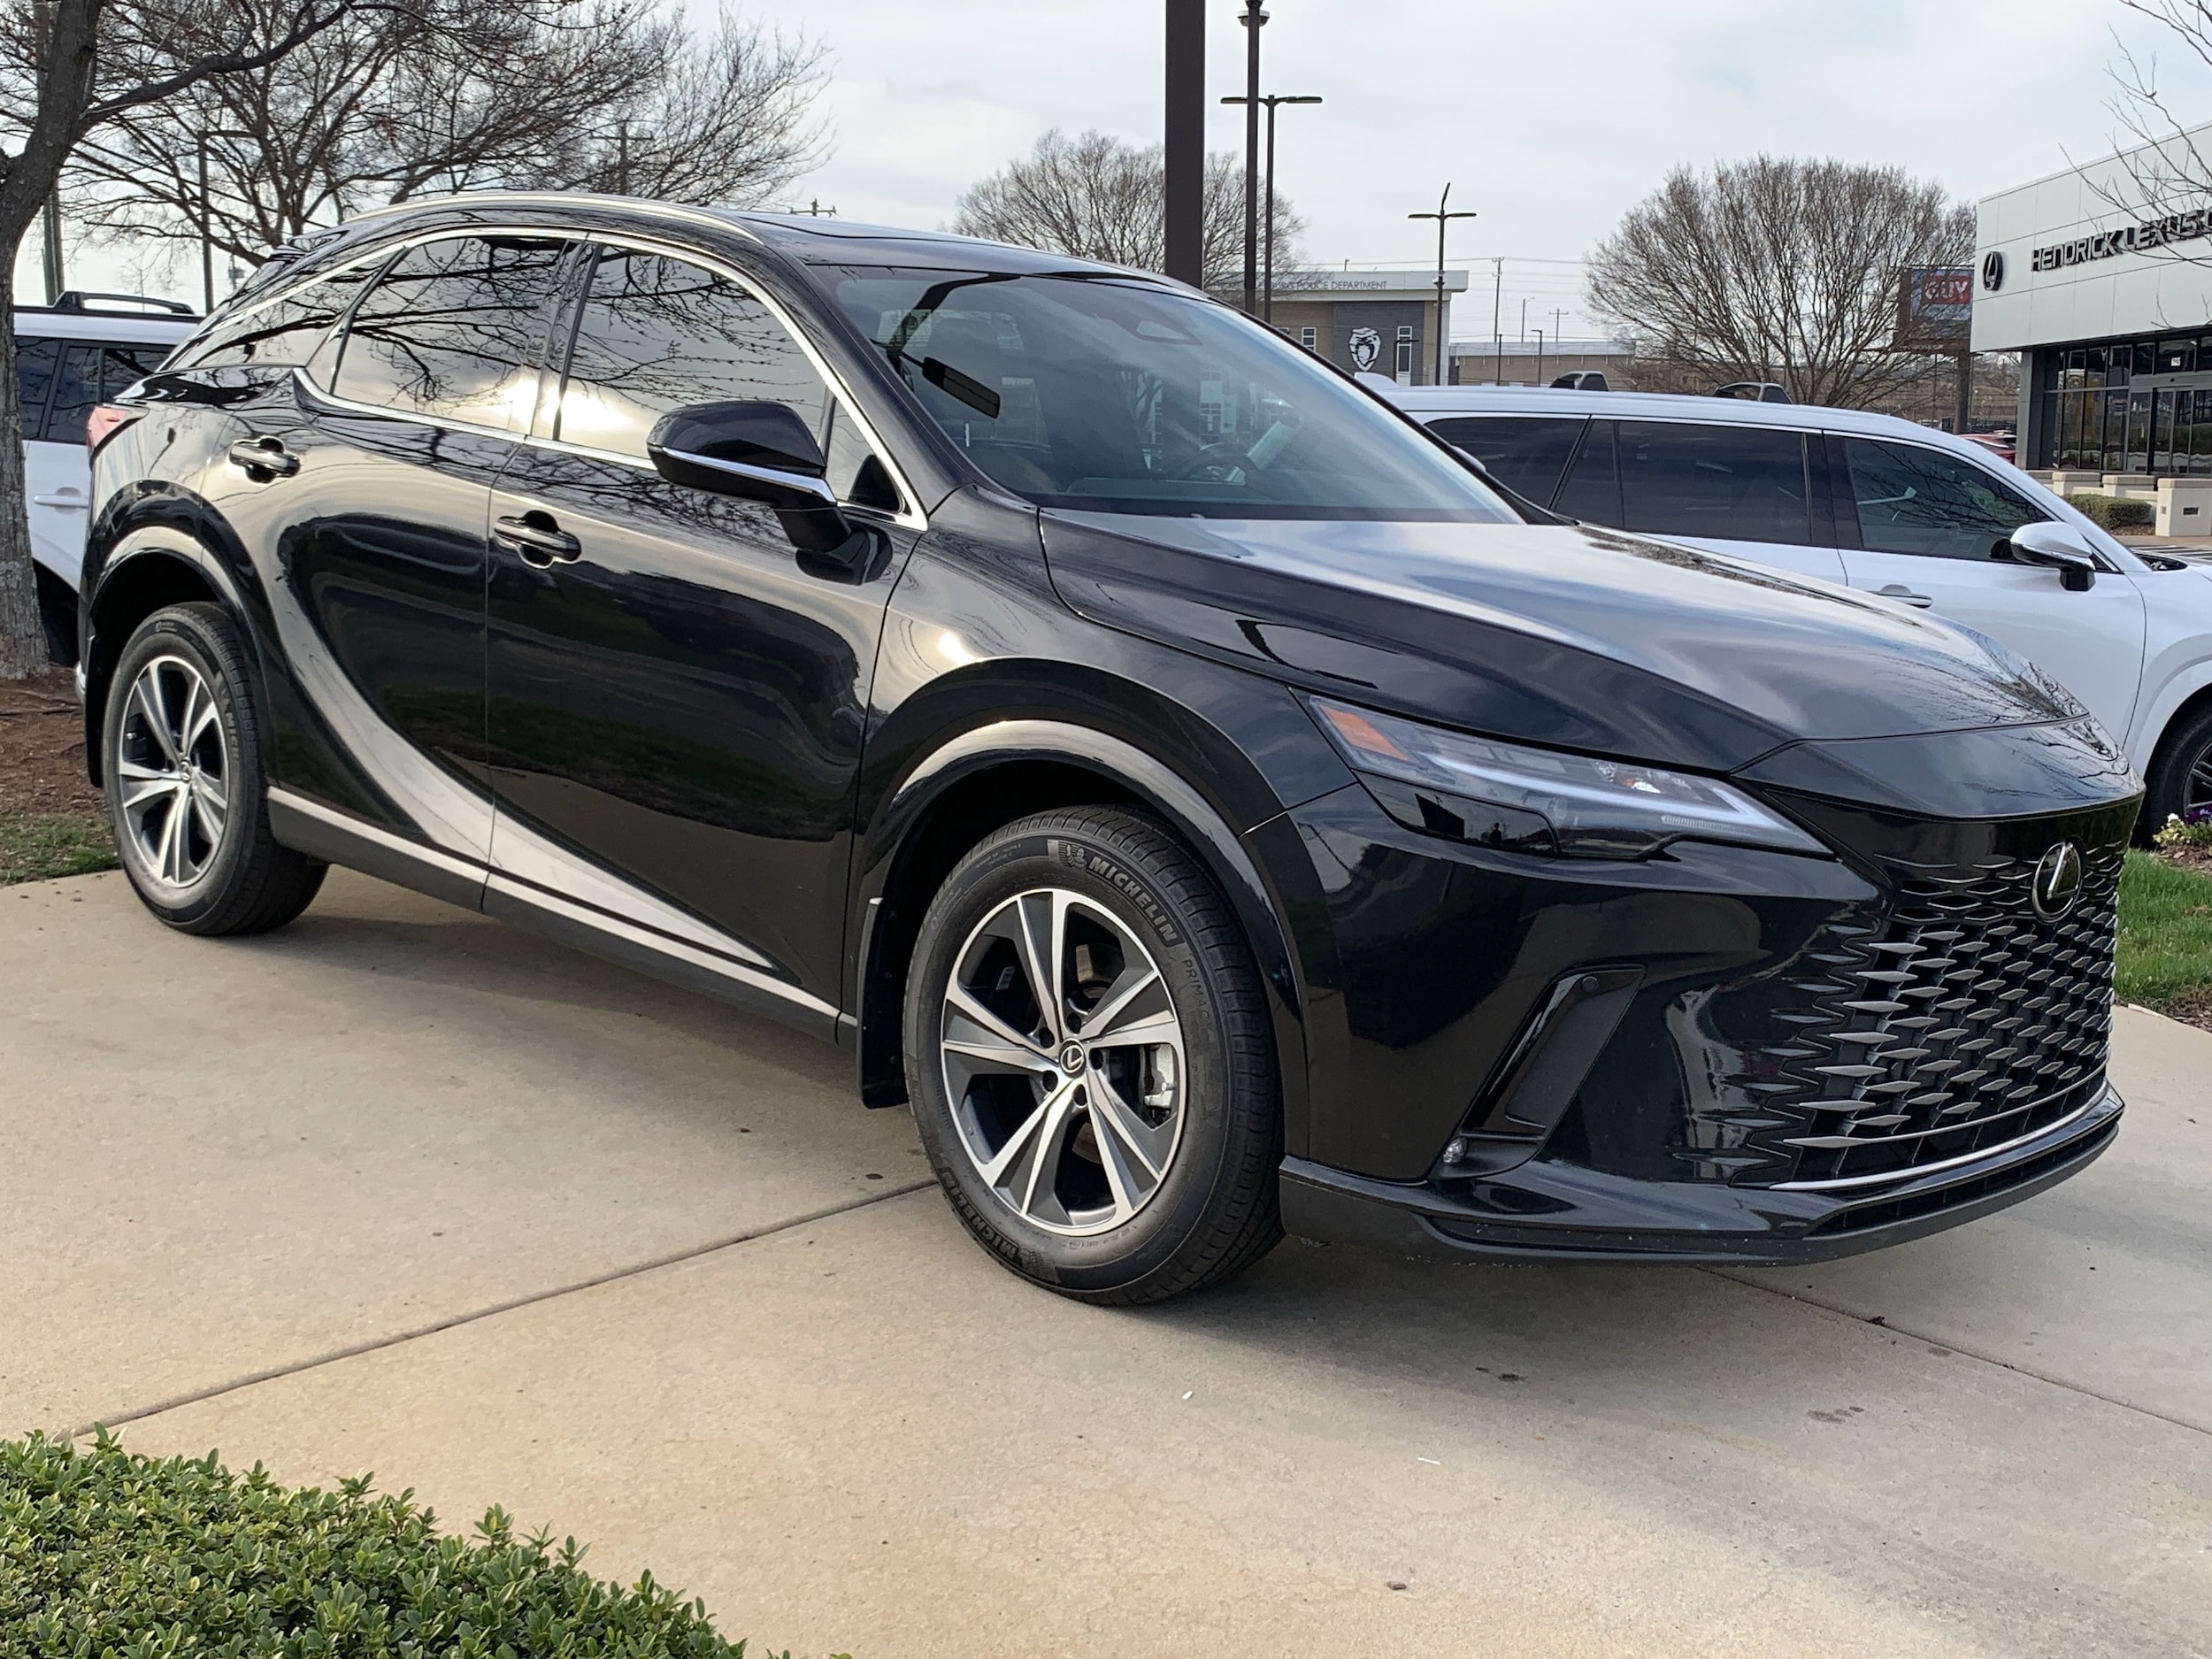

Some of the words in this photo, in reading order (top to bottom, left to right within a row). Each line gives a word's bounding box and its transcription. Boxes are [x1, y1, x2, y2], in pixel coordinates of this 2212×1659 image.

[2032, 230, 2122, 272] HENDRICK
[2124, 210, 2203, 250] LEXUS
[1331, 281, 1387, 290] DEPARTMENT
[1088, 856, 1179, 942] MICHELIN
[941, 1171, 1018, 1258] MICHELIN
